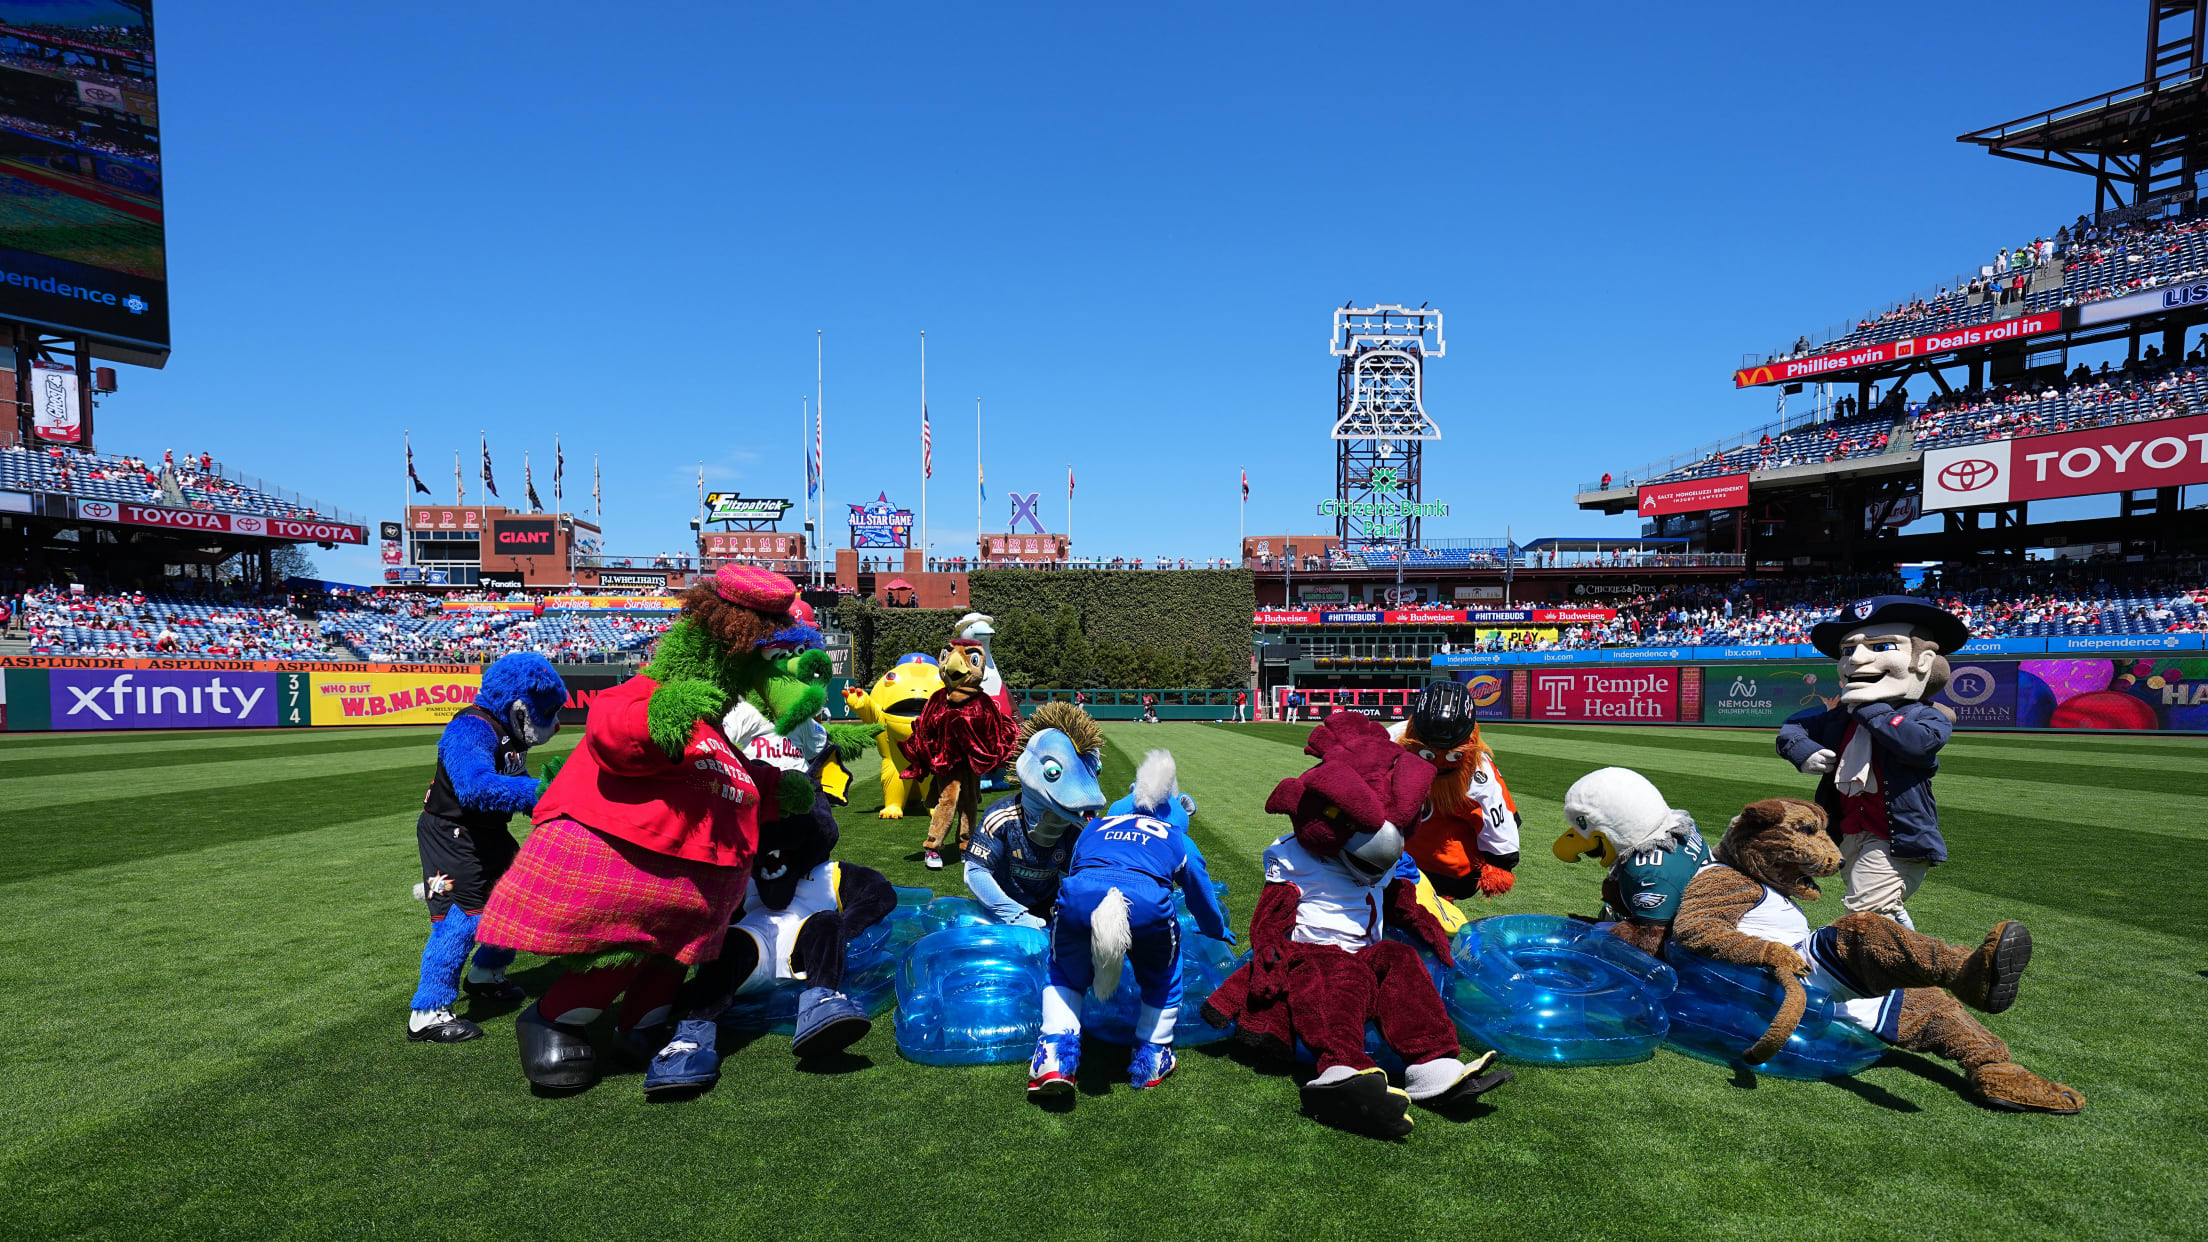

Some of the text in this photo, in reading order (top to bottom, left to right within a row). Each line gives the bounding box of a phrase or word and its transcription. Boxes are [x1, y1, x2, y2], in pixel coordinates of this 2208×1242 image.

[0, 271, 117, 306] endence
[1926, 318, 2042, 352] Deals roll in
[1787, 348, 1884, 377] Phillies win
[712, 493, 784, 512] Fitzpatrick
[1320, 498, 1448, 517] Citizens Bank
[128, 506, 223, 529] TOYOTA
[848, 513, 913, 526] ALL STAR GAME
[275, 521, 355, 541] TOYOTA
[1362, 519, 1404, 537] Park
[499, 532, 550, 543] GIANT
[760, 537, 770, 548] 14
[1257, 541, 1269, 552] 42
[491, 580, 522, 588] Fanatics
[552, 597, 590, 609] Surfside
[624, 597, 662, 609] Surfside
[1328, 611, 1377, 622] #HITTHEBUDS
[1475, 611, 1525, 621] #HITTHEBUDS
[1511, 632, 1539, 642] PLY
[2068, 637, 2161, 648] Independence
[1725, 647, 1762, 657] ibx.com
[1960, 643, 2001, 651] x.com
[1447, 655, 1492, 664] Independence
[1544, 652, 1574, 661] ibx.com
[1613, 650, 1669, 660] Independence
[0, 657, 124, 668] ASPLUNDH
[149, 660, 256, 670] ASPLUNDH
[275, 662, 368, 672] ASPLUNDH
[389, 664, 471, 674] ASPLUNDH
[320, 684, 371, 694] WHO BUT
[1583, 674, 1669, 698] Temple
[66, 673, 266, 721] xfinity
[1583, 699, 1663, 717] Health
[1718, 700, 1772, 708] NEMOURS
[1952, 707, 2010, 715] THMAN
[1096, 813, 1172, 840] 76
[1104, 831, 1151, 846] COATY
[969, 844, 992, 861] IBX
